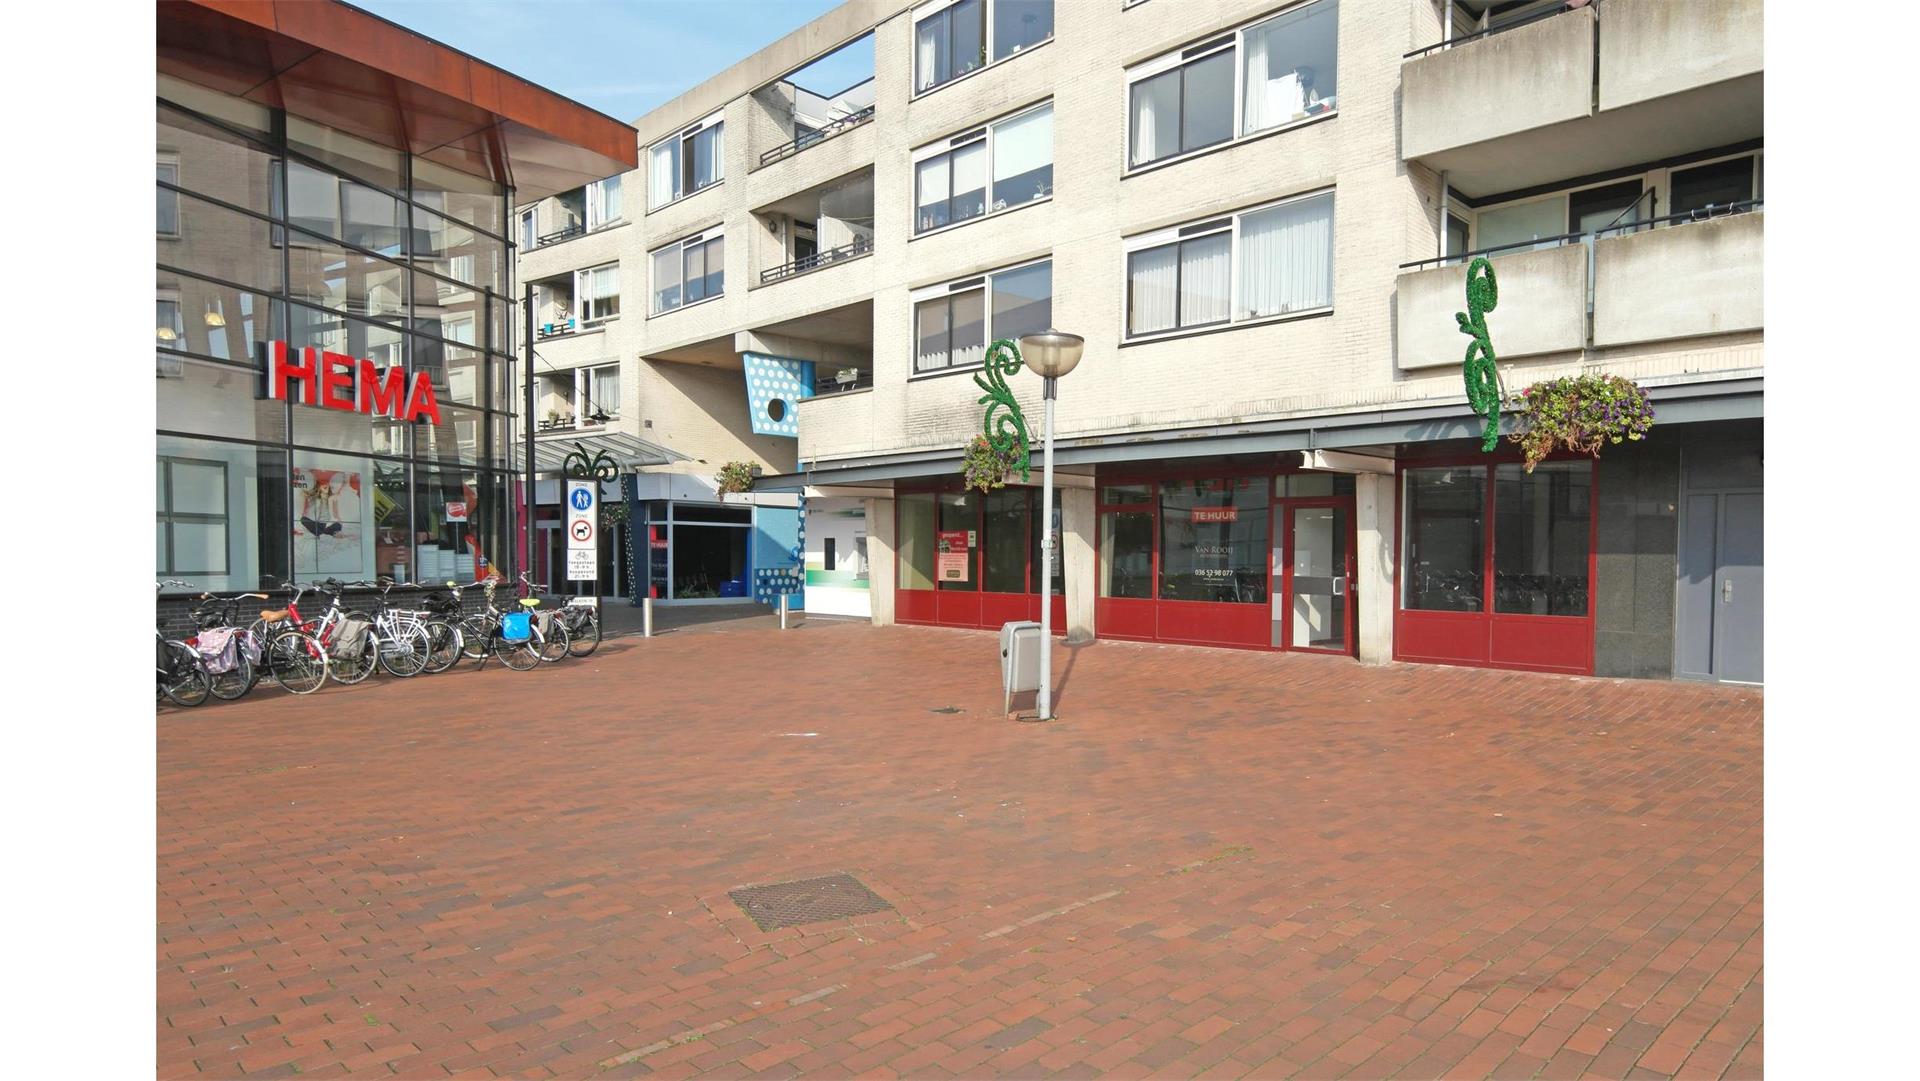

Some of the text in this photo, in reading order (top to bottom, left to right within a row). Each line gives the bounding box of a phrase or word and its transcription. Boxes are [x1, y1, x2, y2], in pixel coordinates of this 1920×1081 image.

[268, 339, 441, 425] HEMA
[1194, 511, 1235, 520] TE HUUR
